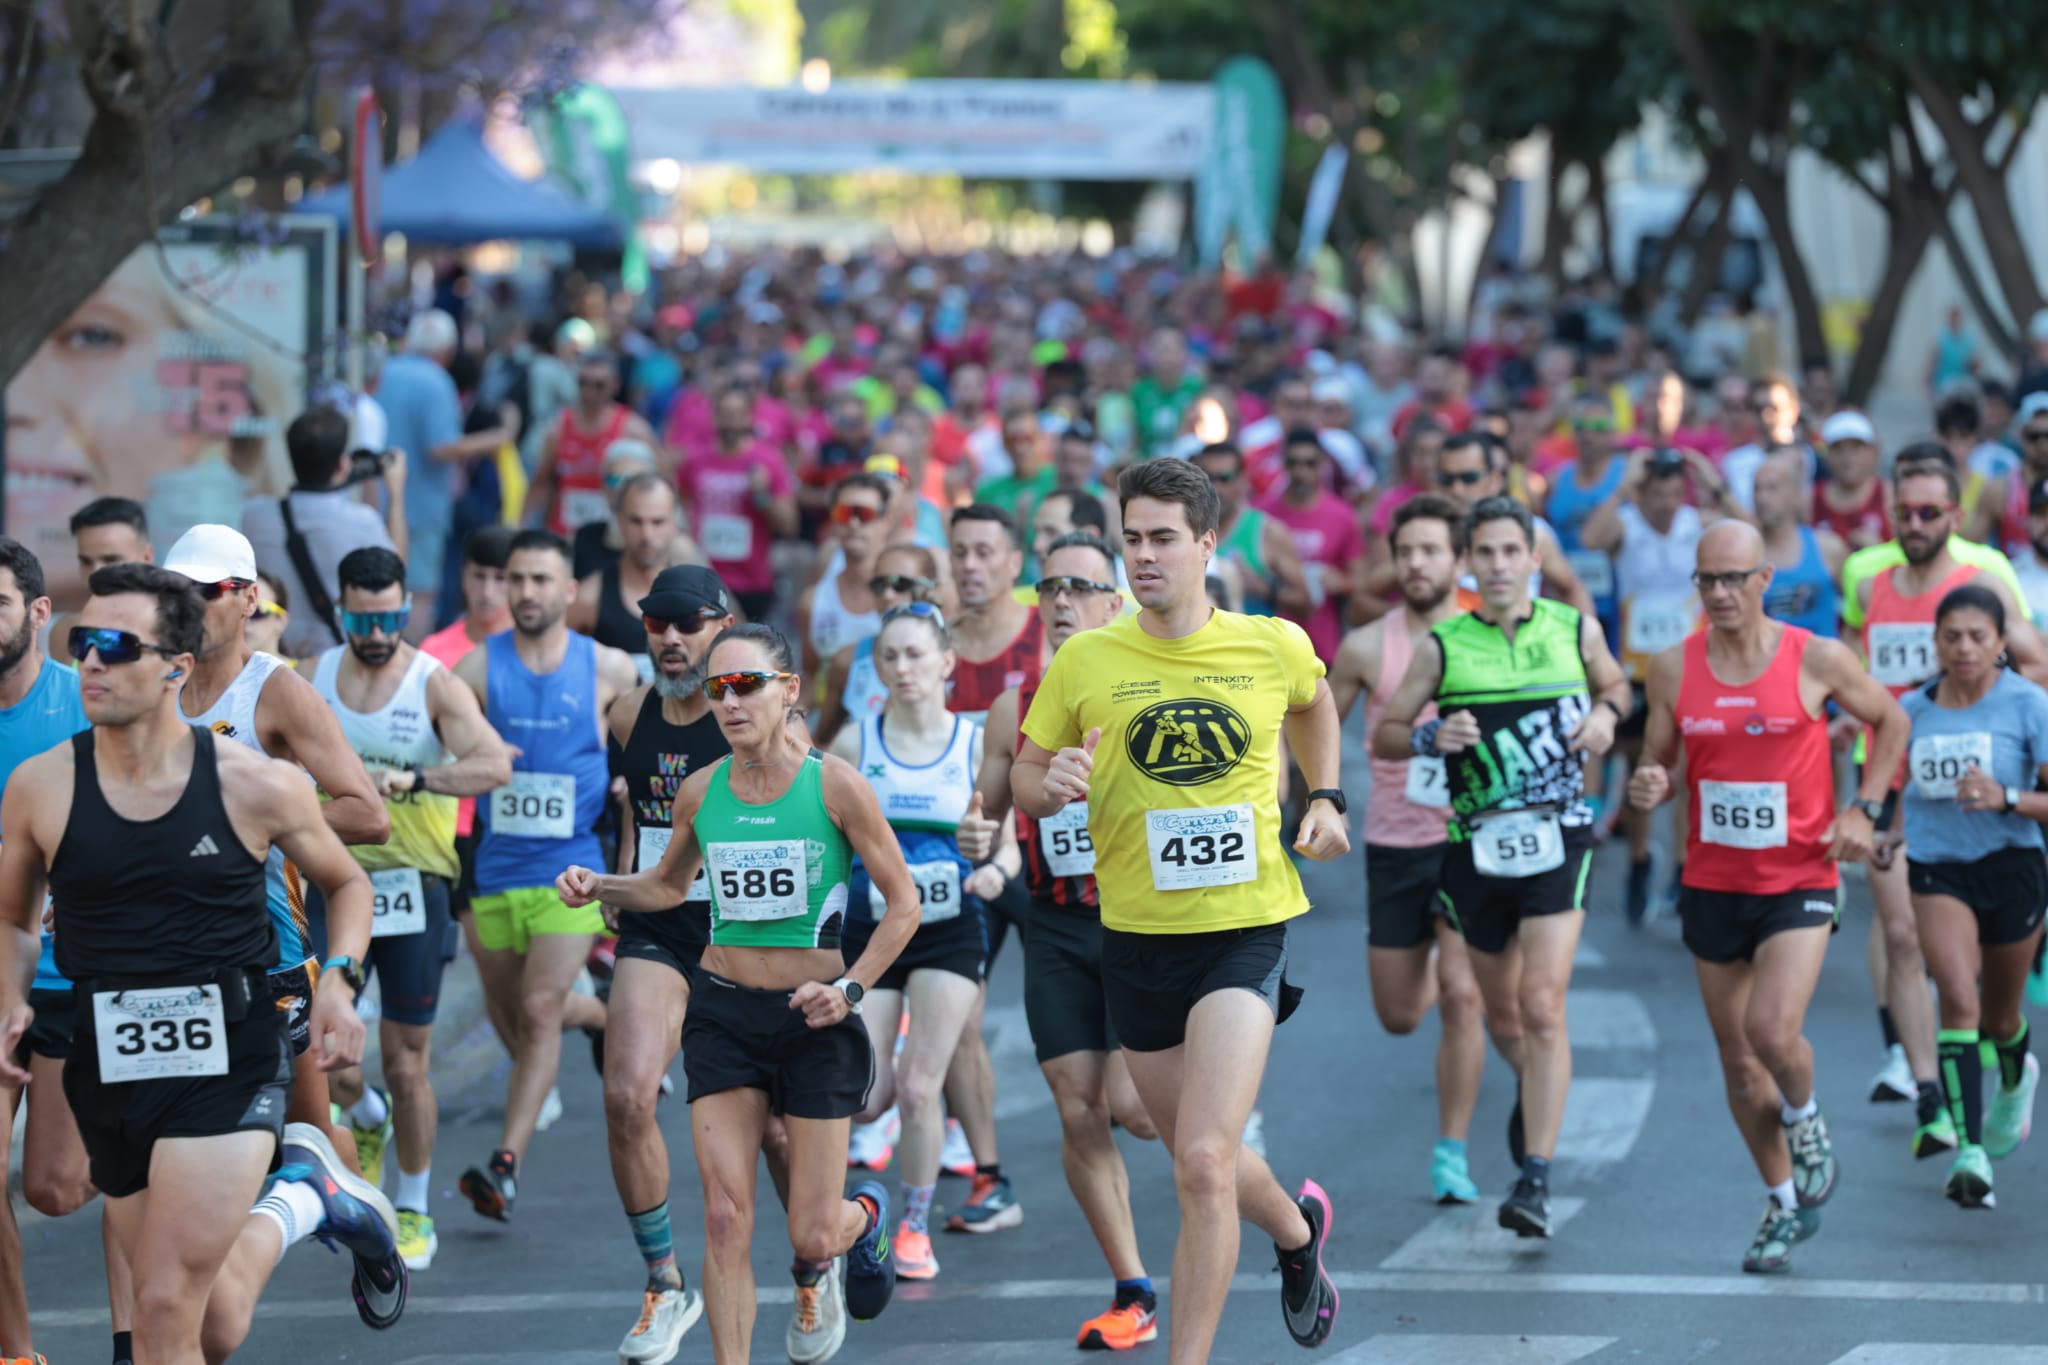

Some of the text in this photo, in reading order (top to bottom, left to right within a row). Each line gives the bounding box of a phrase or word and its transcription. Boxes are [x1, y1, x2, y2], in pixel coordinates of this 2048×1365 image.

[1194, 675, 1254, 684] INTENXITY
[658, 753, 689, 776] WE
[650, 776, 683, 798] RU
[501, 794, 563, 819] 306
[1711, 804, 1775, 830] 669
[1053, 828, 1094, 856] 55
[1160, 832, 1245, 867] 432
[1497, 833, 1539, 859] 59
[720, 868, 795, 899] 586
[372, 892, 414, 916] 94
[115, 1017, 213, 1056] 336
